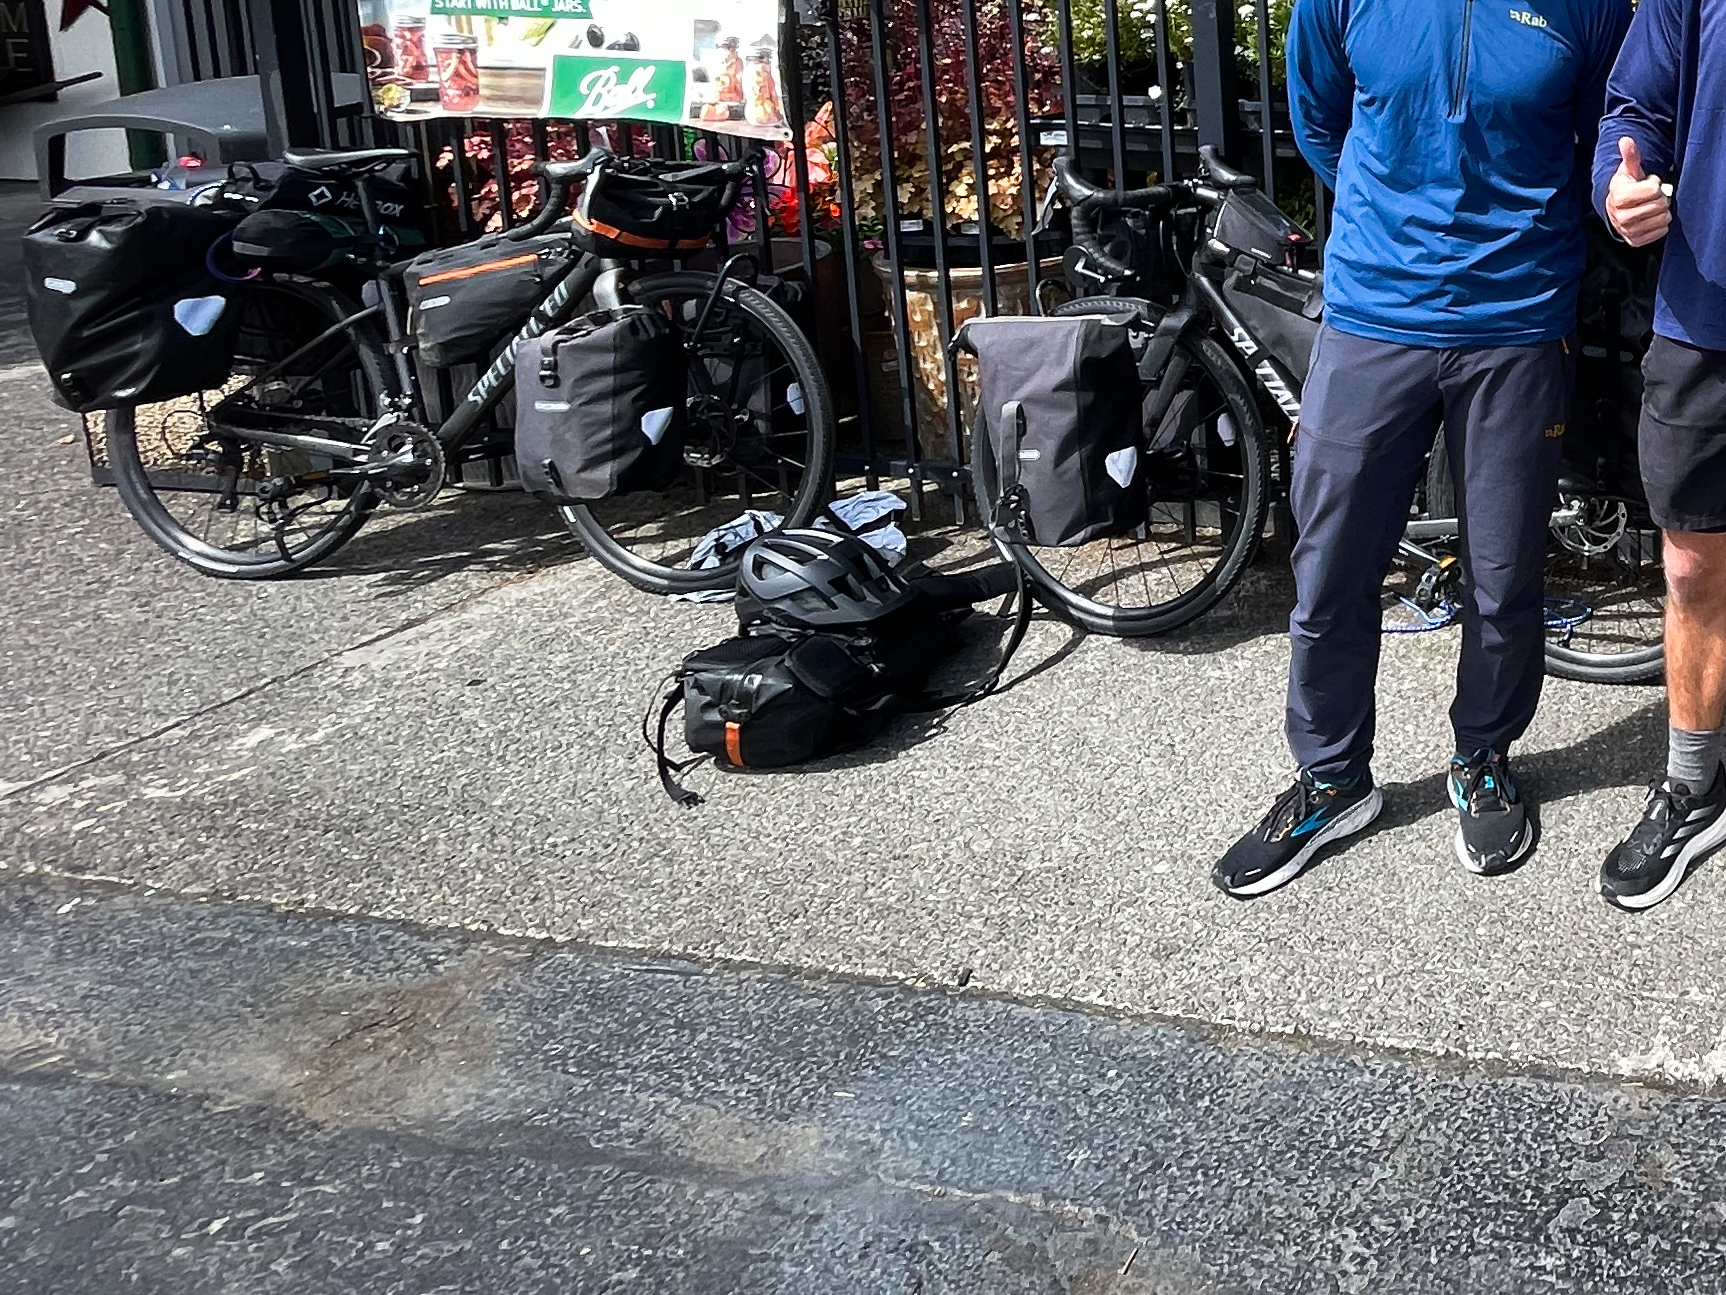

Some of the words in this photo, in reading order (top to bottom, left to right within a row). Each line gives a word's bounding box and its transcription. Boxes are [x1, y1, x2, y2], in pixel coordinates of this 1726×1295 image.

[552, 0, 587, 13] JARS.
[1520, 11, 1548, 28] Rab
[574, 65, 657, 117] Ball
